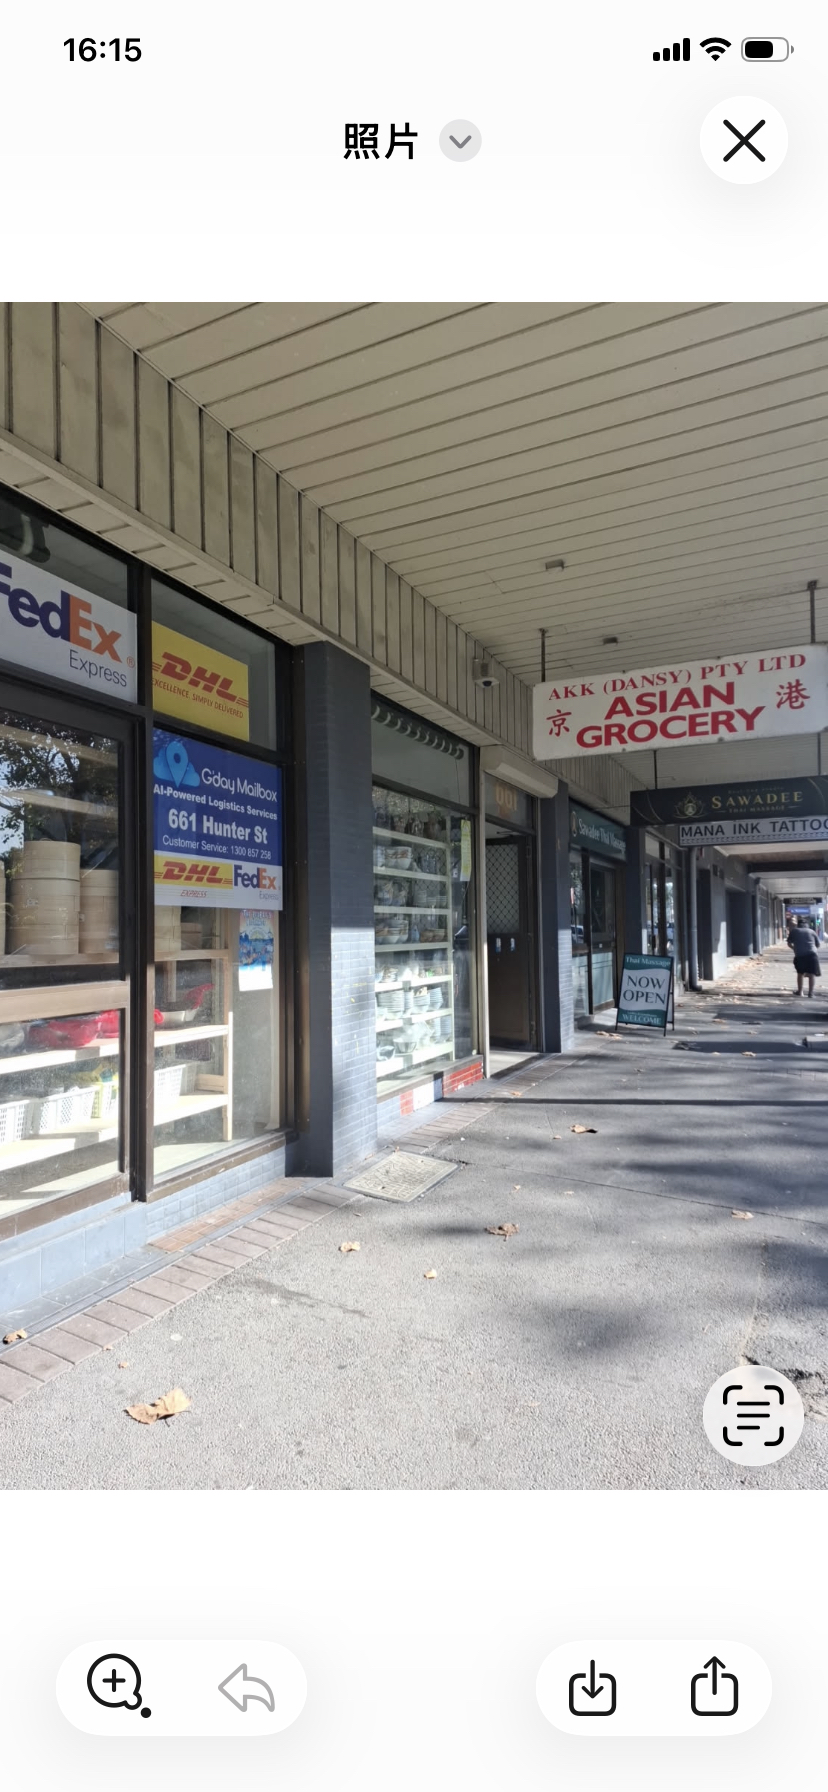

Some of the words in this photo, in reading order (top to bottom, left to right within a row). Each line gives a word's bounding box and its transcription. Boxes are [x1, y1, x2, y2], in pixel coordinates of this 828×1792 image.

[69, 649, 127, 687] Express
[160, 651, 238, 703] DHL
[549, 682, 596, 701] AKK
[603, 669, 692, 695] (DANSY)
[700, 660, 748, 680] PTY
[758, 653, 807, 673] LTD
[192, 693, 213, 707] SIMPLY
[214, 702, 244, 718] DELIVERED
[604, 681, 735, 720] ASIAN
[775, 678, 811, 710] 港
[546, 708, 572, 737] 京
[576, 705, 766, 748] GROCERY
[201, 767, 236, 795] G'day
[237, 777, 278, 802] Mailbox
[153, 783, 206, 804] AI-Powered
[208, 796, 245, 814] Logistics
[247, 805, 278, 821] Services
[711, 791, 804, 809] SAWADEE
[168, 808, 197, 832] 661
[202, 815, 251, 841] Hunter
[254, 825, 268, 845] St
[681, 824, 725, 838] MANA
[733, 822, 760, 835] INK
[162, 834, 200, 849] Customer
[201, 840, 229, 854] Service:
[230, 845, 246, 856] 1300
[247, 848, 259, 858] 857
[260, 850, 271, 860] 258
[162, 860, 224, 884] DHL
[233, 864, 277, 890] FedEx
[626, 956, 640, 964] Thai
[641, 958, 671, 968] Massage
[623, 989, 666, 1005] OPEN
[627, 975, 665, 989] NOW
[622, 1013, 661, 1025] WELCOME
